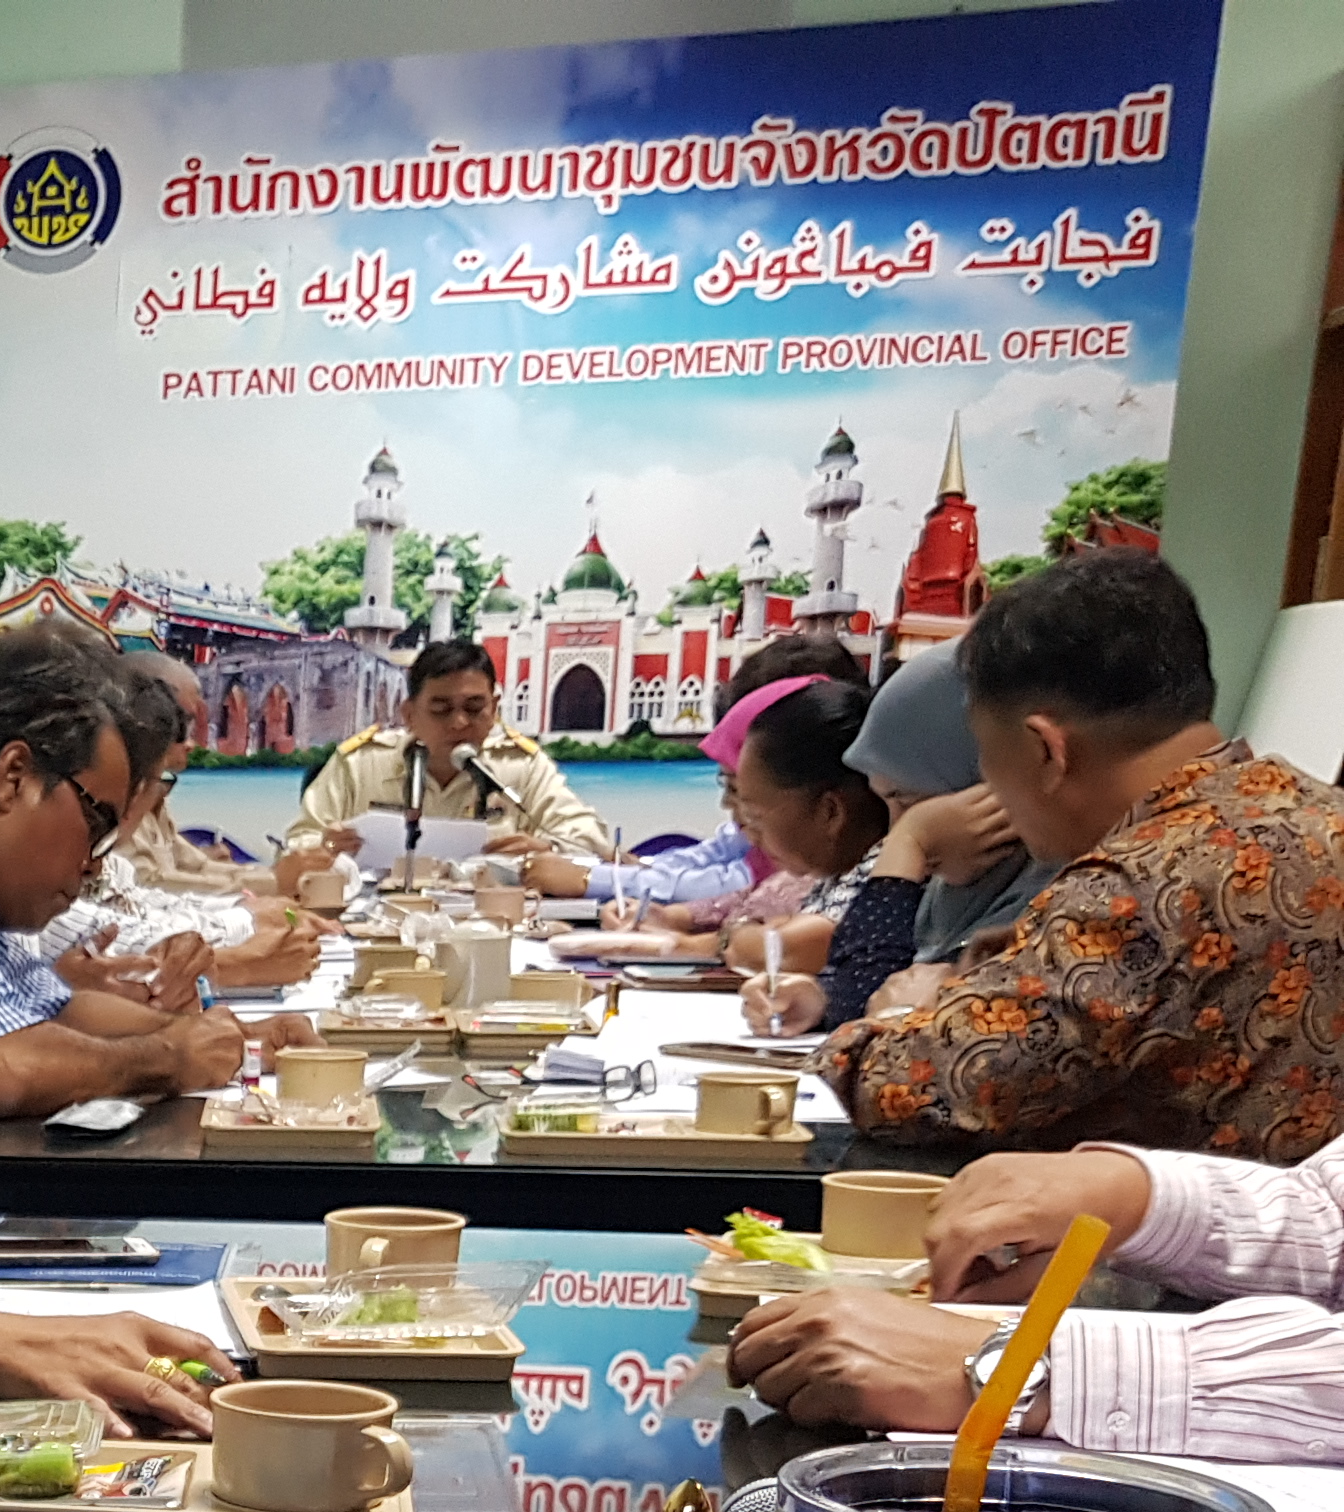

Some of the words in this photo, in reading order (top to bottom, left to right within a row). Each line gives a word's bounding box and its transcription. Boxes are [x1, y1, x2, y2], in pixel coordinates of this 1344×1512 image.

[162, 90, 1166, 217] สำนักงานพัฒนาชุมชนจังหวัดปัตตานี
[162, 366, 295, 400] PATTANI
[312, 355, 509, 391] COMMUNITY
[522, 341, 768, 384] DEVELOPMENT
[779, 332, 987, 372] PROVINCIAL
[1002, 325, 1129, 360] OFFICE
